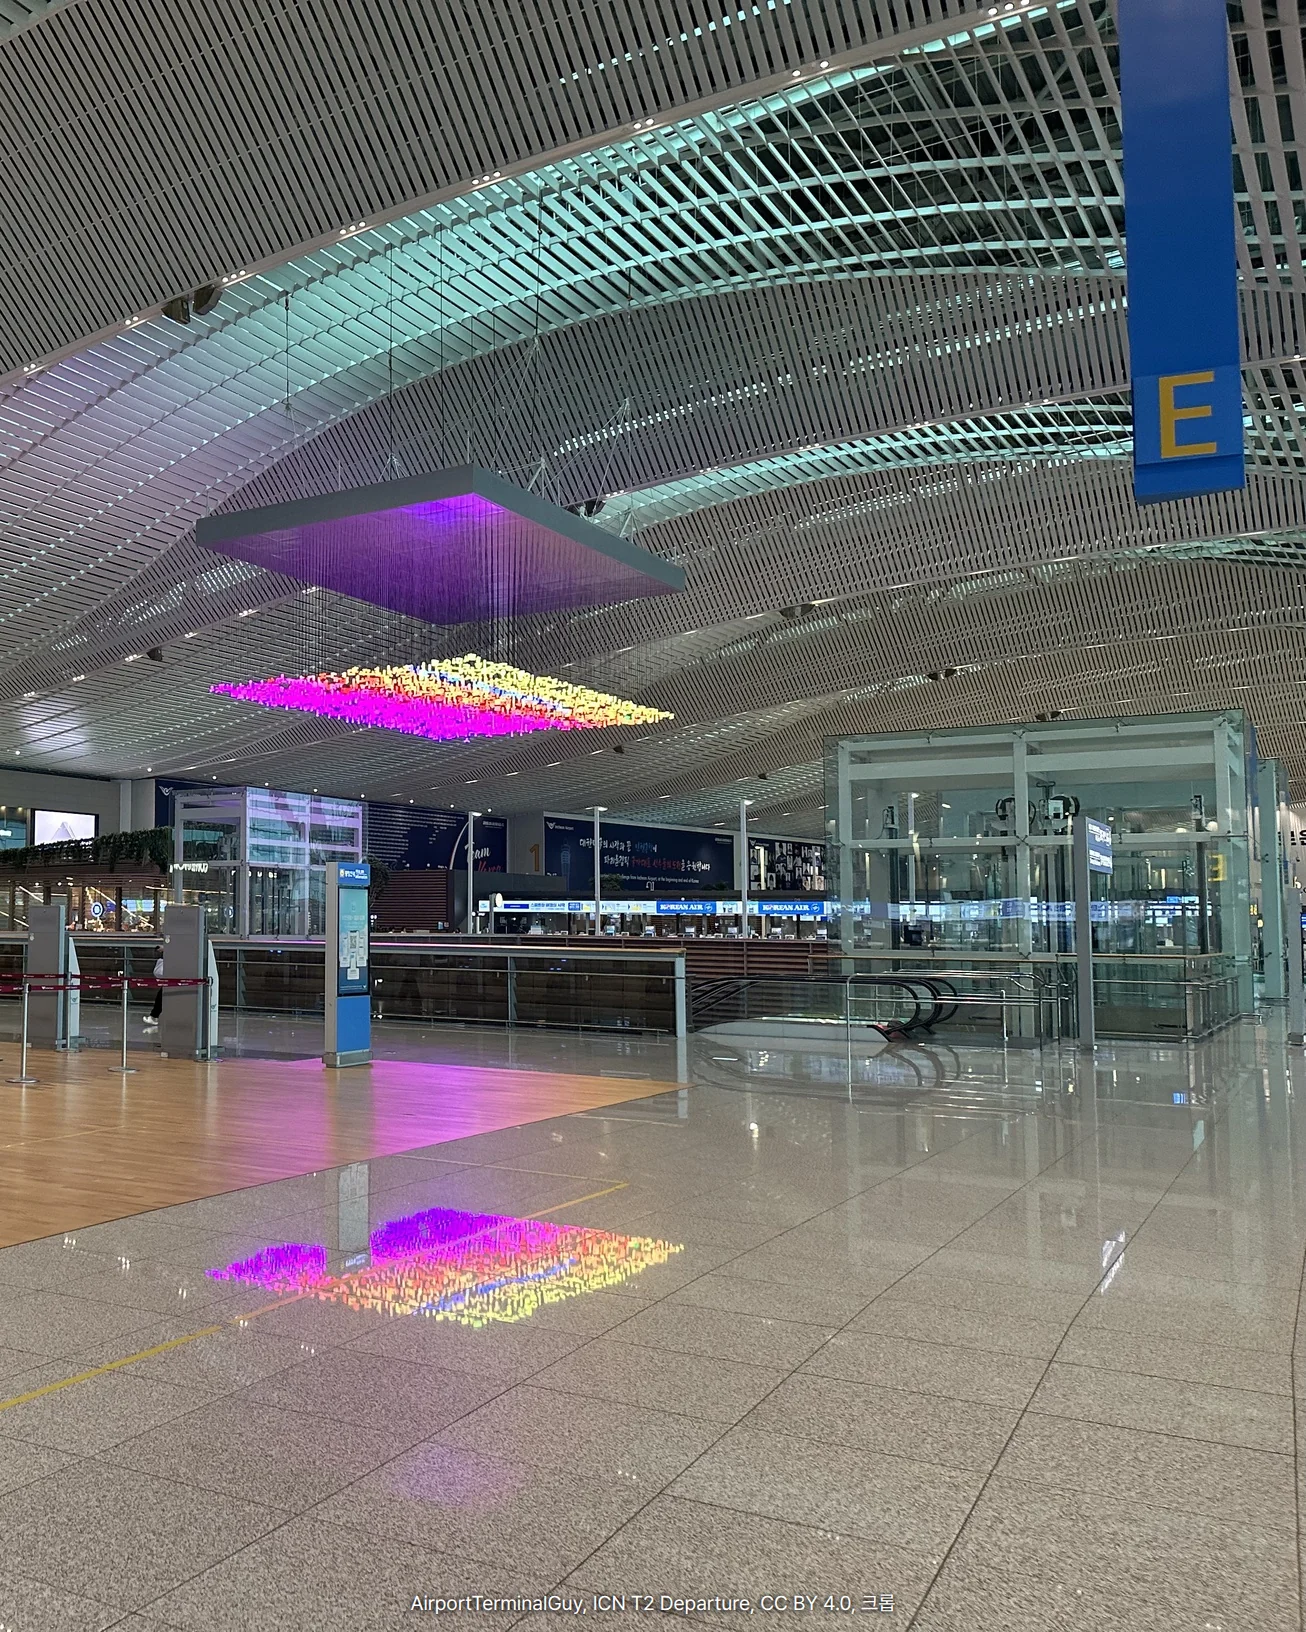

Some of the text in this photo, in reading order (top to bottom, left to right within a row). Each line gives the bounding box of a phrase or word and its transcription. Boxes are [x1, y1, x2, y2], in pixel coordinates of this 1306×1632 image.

[1159, 370, 1217, 459] E
[529, 844, 540, 871] 1
[660, 903, 704, 911] KOREAN AIR
[793, 904, 810, 912] AIR
